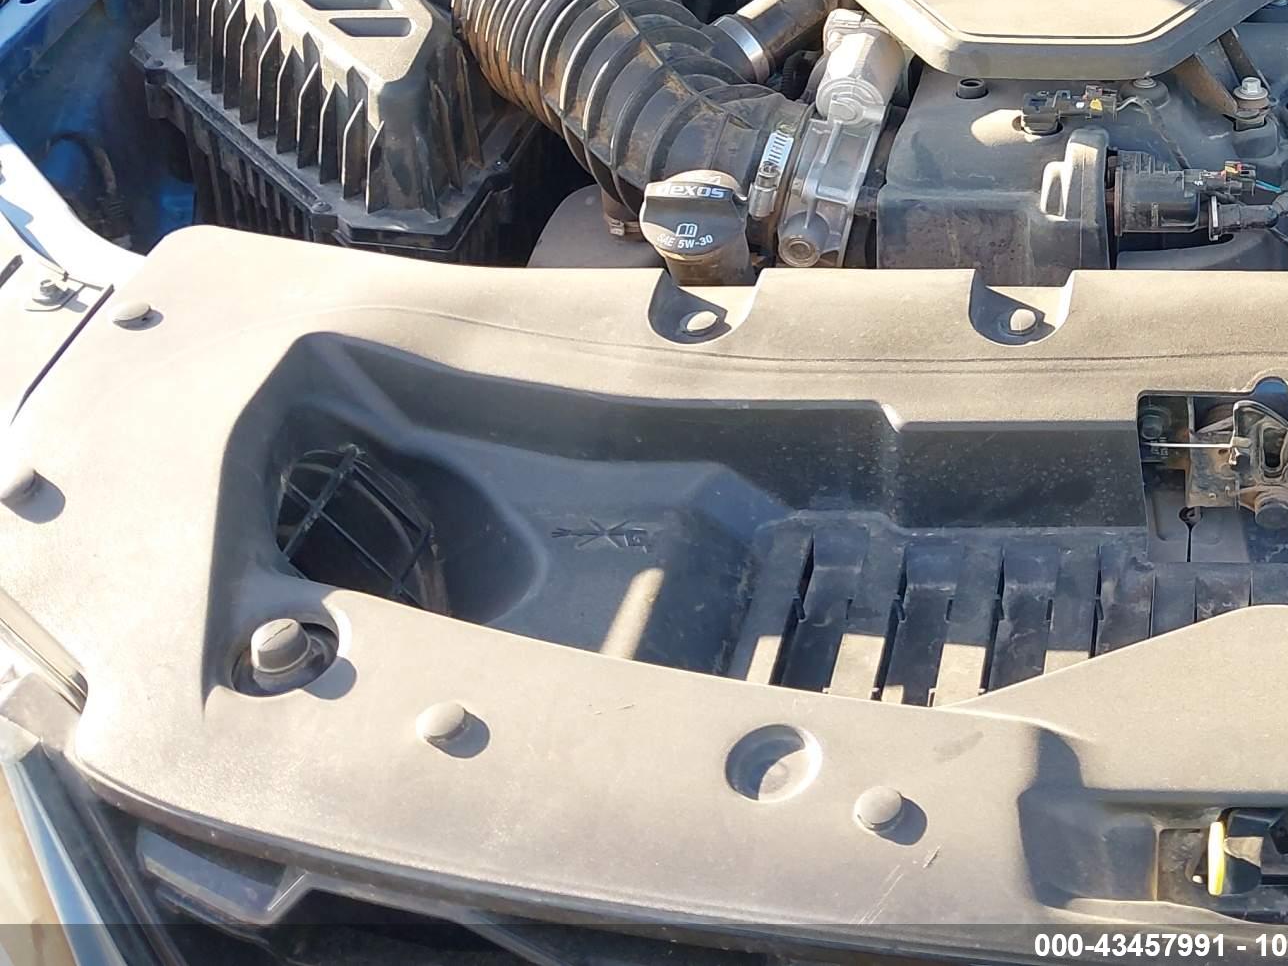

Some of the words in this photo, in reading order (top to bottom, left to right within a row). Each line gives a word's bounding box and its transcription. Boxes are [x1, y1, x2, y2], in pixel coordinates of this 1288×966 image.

[656, 181, 725, 199] dexos
[657, 233, 676, 247] SAE
[677, 234, 713, 249] 5W-30
